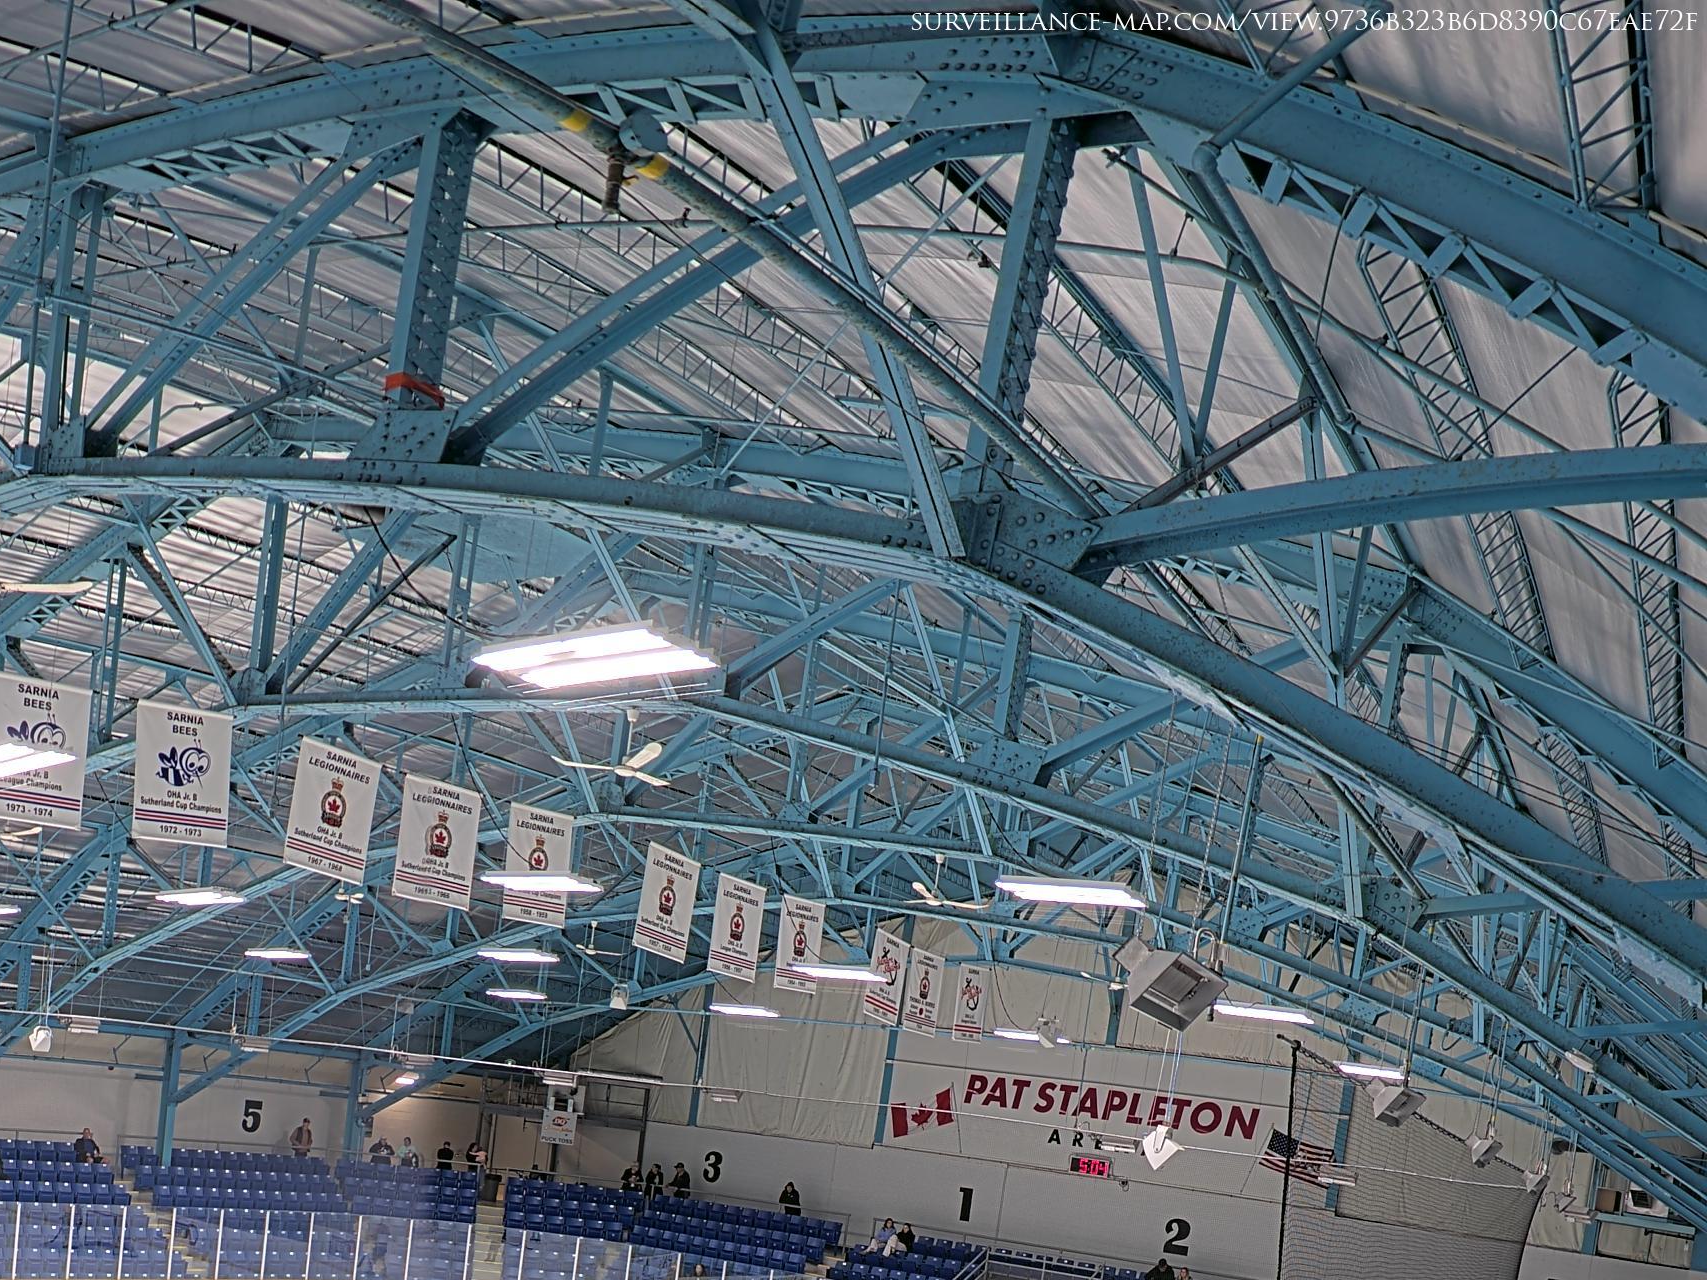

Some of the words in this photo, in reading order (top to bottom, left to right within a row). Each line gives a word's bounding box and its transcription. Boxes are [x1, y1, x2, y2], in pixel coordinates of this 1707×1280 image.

[18, 683, 60, 700] SARNIA
[23, 698, 52, 711] BEES
[167, 711, 204, 726] SARNIA
[172, 725, 198, 737] BEES
[326, 751, 357, 769] SARNIA
[308, 757, 371, 785] LEGIONNAIRES
[26, 778, 62, 791] Champions
[432, 786, 460, 801] SARNIA
[167, 790, 181, 800] OHA
[6, 803, 26, 814] 1973
[34, 807, 53, 817] 1974
[140, 796, 174, 808] Sutherland
[175, 800, 188, 811] Cup
[189, 802, 222, 814] Champions
[530, 812, 554, 825] SARNIA
[516, 819, 565, 837] LEGIONNAIRES
[652, 857, 693, 881] LEGIONNAIRES
[963, 1074, 1033, 1110] PAT
[1033, 1081, 1261, 1140] STAPLETON
[241, 1100, 263, 1134] 5
[702, 1150, 724, 1184] 3
[1078, 1157, 1109, 1177] 5:04
[958, 1187, 972, 1222] 1
[1163, 1218, 1192, 1256] 2
